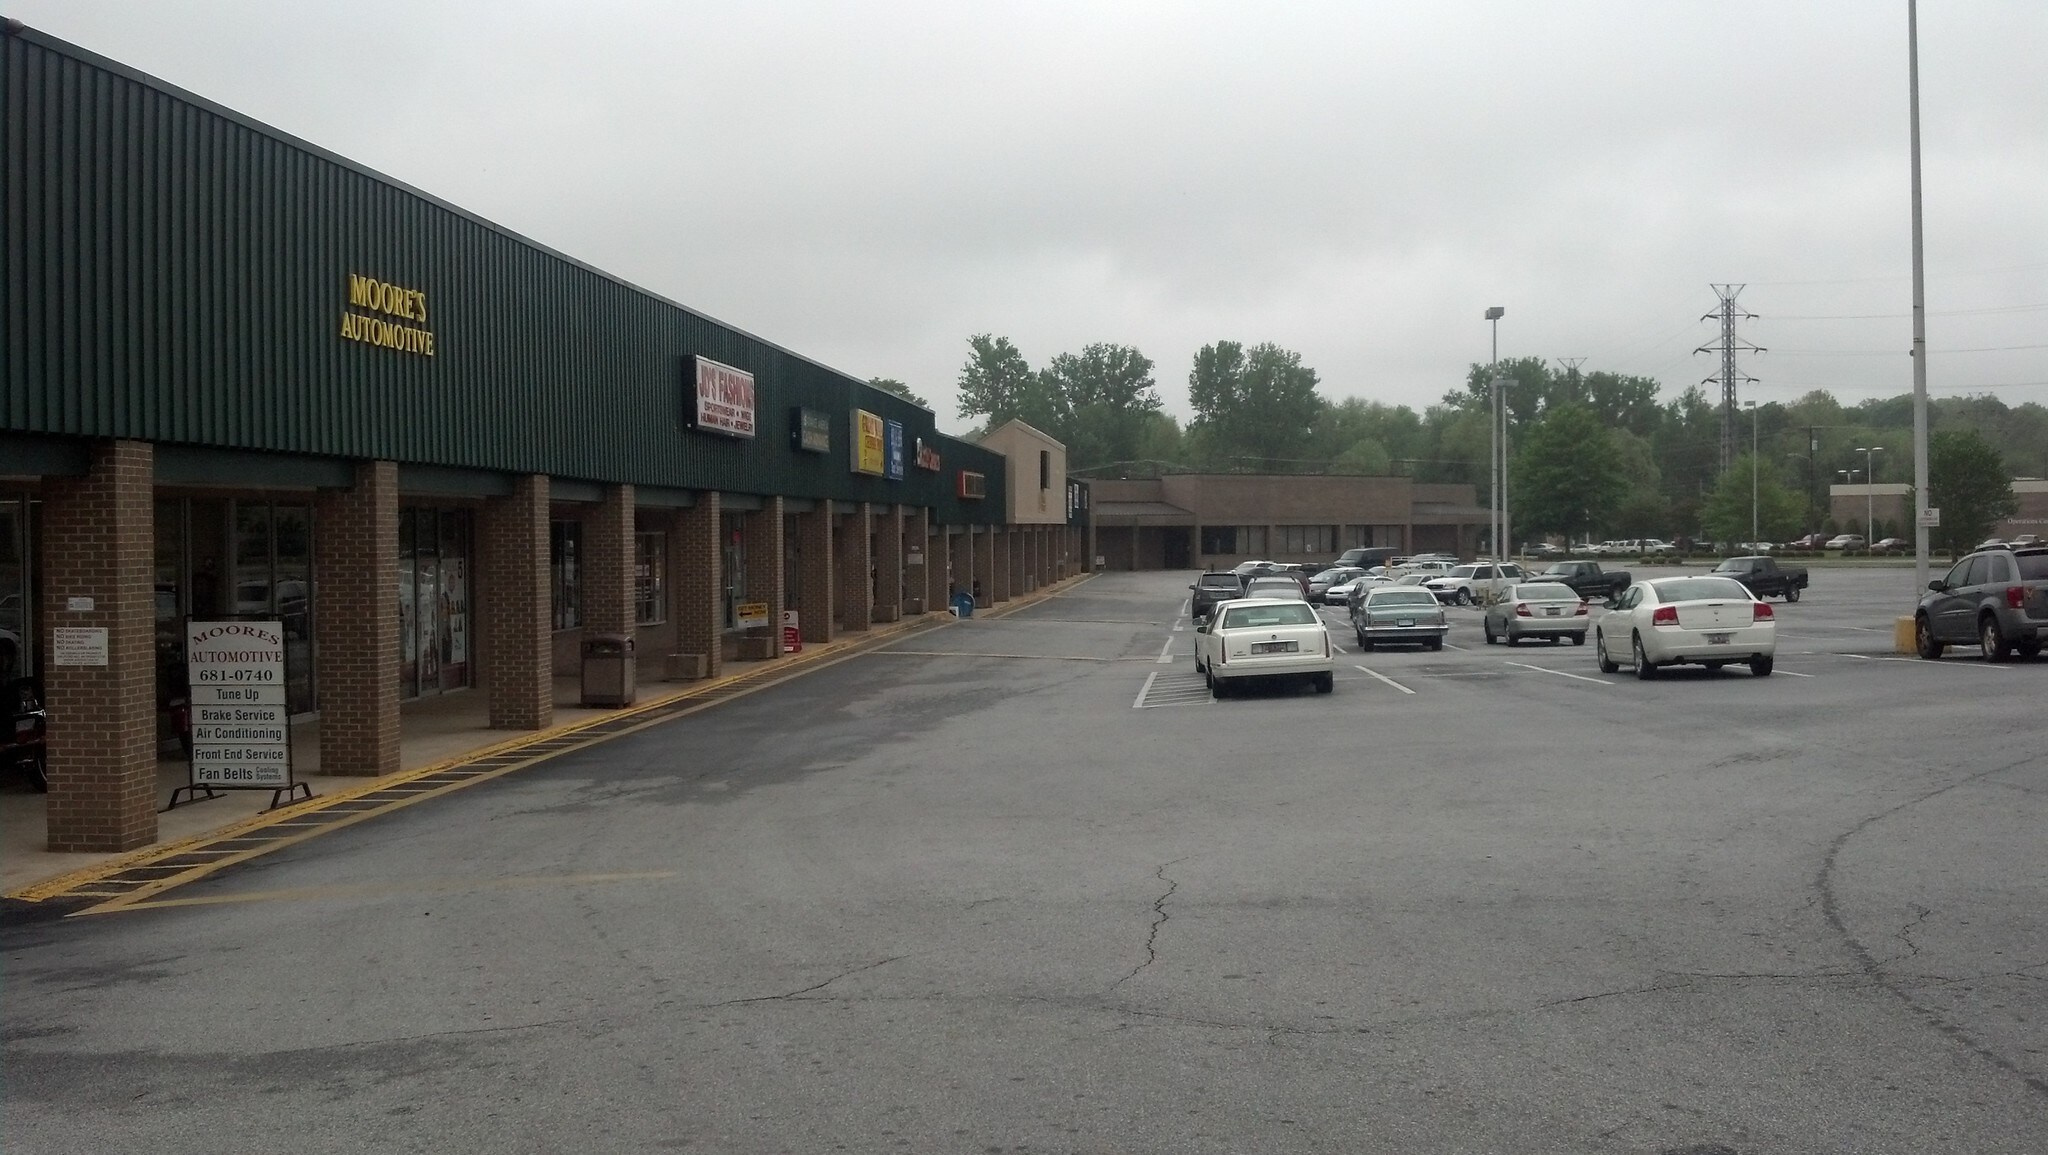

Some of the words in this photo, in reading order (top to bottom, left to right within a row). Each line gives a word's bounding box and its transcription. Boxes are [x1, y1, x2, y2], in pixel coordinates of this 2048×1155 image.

[349, 273, 426, 323] MOORE'S
[340, 311, 434, 356] AUTOMOTIVE
[192, 625, 280, 645] MOORES
[191, 651, 283, 663] AUTOMOTIVE
[200, 670, 273, 681] 681-0740
[216, 688, 241, 700] Tune
[245, 688, 259, 702] Up
[202, 709, 232, 721] Brake
[235, 709, 275, 721] Service
[196, 727, 212, 739] Air
[215, 727, 282, 741] Conditioning
[195, 748, 221, 760] Front
[224, 748, 243, 760] End
[245, 748, 284, 760] Service
[199, 767, 220, 780] Fan
[223, 767, 253, 780] Belts
